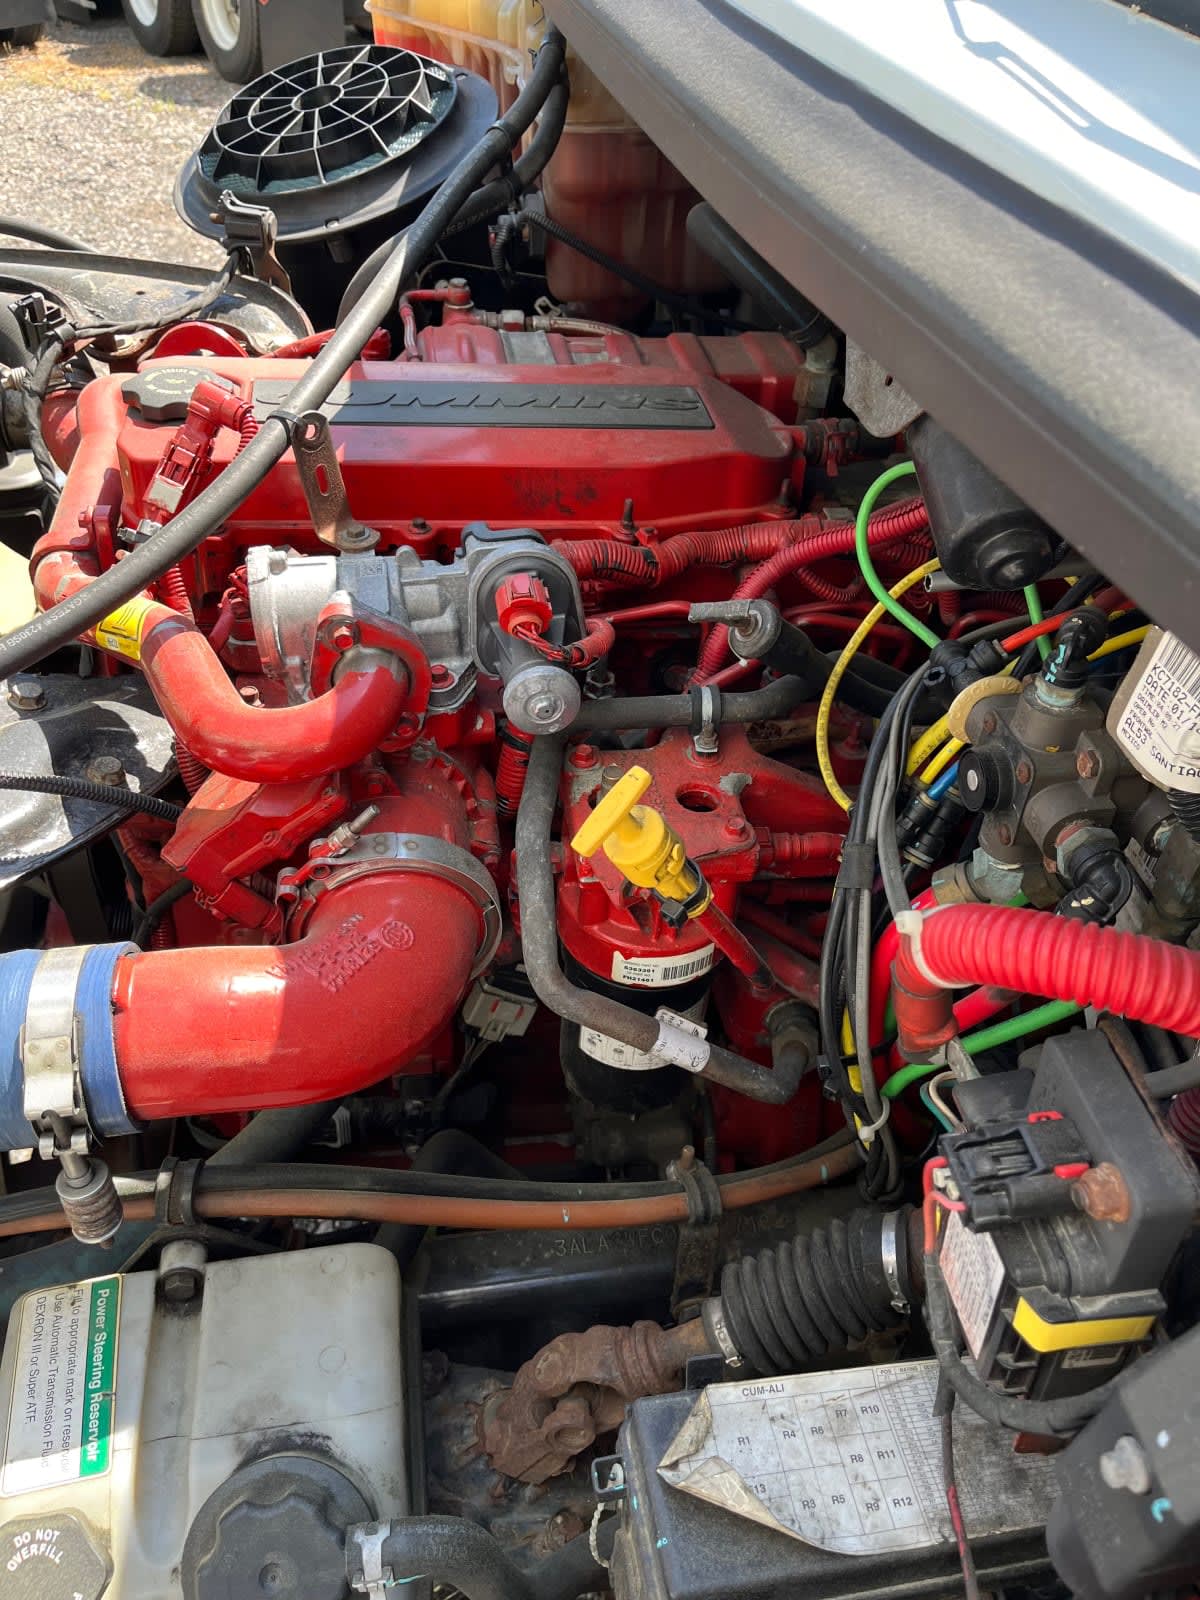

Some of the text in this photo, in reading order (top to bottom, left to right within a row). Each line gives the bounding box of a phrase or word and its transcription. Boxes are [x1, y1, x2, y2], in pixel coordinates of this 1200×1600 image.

[1125, 717, 1147, 745] AL53
[54, 1292, 65, 1312] Use
[32, 1296, 47, 1343] DEXRON
[48, 1314, 63, 1365] Automatic
[66, 1317, 80, 1375] appropriate
[86, 1288, 110, 1462] Power Steering Reservoir
[26, 1369, 40, 1397] Super
[65, 1377, 74, 1405] mark
[742, 1384, 785, 1398] CUM-ALI
[43, 1366, 59, 1438] Transmission
[63, 1407, 72, 1420] on
[835, 1408, 848, 1419] R7
[860, 1405, 880, 1416] R10
[737, 1436, 750, 1447] R1
[782, 1429, 797, 1440] R4
[851, 1453, 864, 1464] R8
[877, 1450, 896, 1460] R11
[802, 1499, 817, 1510] R3
[832, 1494, 846, 1505] R5
[893, 1497, 913, 1508] R12
[866, 1502, 880, 1512] R9
[13, 1528, 60, 1549] DO NOT
[7, 1543, 64, 1571] OVERFILL
